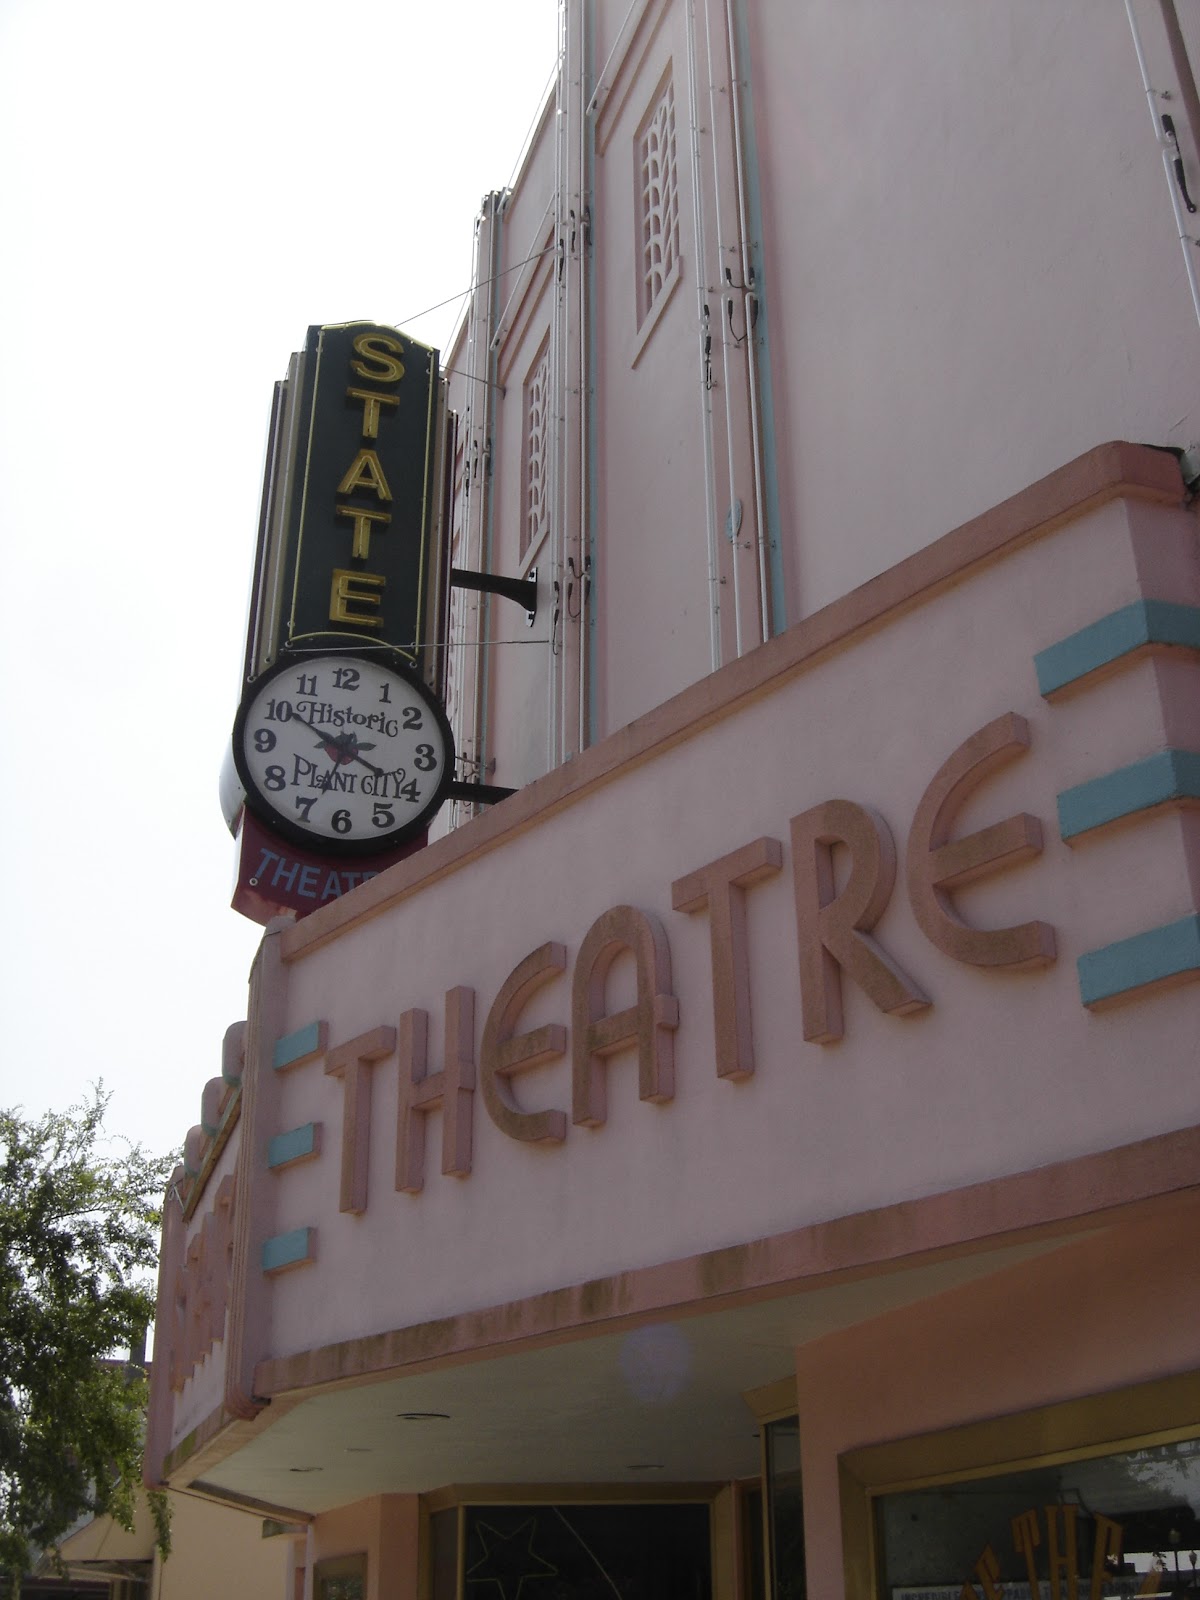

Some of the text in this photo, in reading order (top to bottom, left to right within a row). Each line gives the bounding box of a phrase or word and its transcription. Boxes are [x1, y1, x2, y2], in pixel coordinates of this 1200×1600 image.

[329, 333, 405, 627] STATE
[296, 674, 318, 697] 11
[332, 668, 360, 690] 12
[379, 683, 392, 703] 1
[264, 699, 293, 722] 10
[402, 707, 422, 730] 2
[254, 729, 276, 753] 9
[414, 744, 437, 771] 3
[264, 765, 286, 791] 8
[401, 778, 421, 803] 4
[295, 795, 318, 823] 7
[331, 809, 352, 834] 6
[372, 803, 395, 828] 5
[324, 711, 1057, 1214] THEATRE
